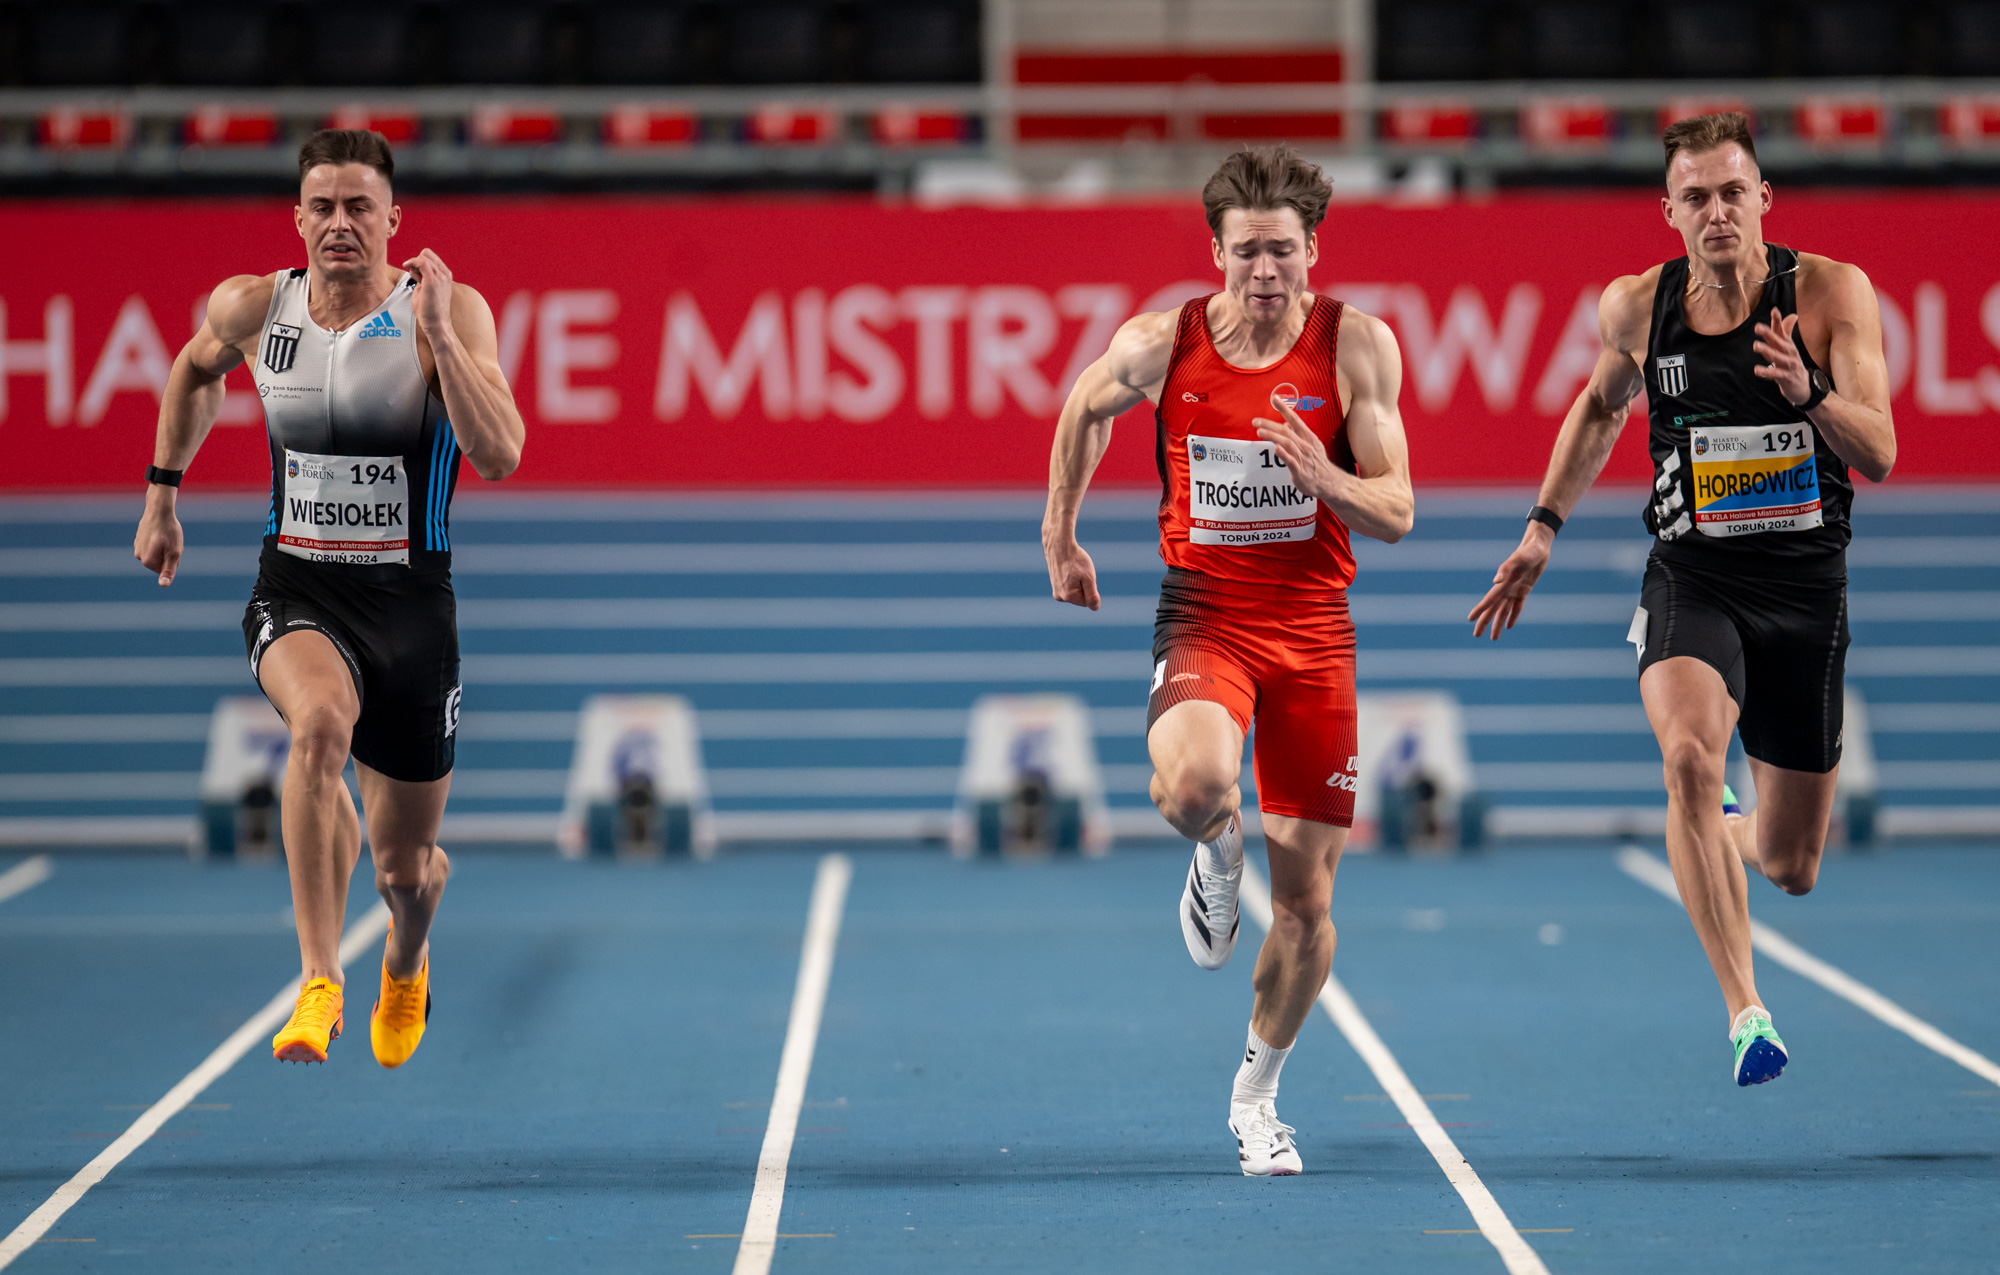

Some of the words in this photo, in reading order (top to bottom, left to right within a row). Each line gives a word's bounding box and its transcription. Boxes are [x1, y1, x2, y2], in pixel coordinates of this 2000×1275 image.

[280, 327, 290, 335] W
[359, 327, 402, 339] adidas
[1711, 440, 1747, 452] TORUŃ
[1762, 429, 1807, 452] 191
[1209, 453, 1244, 464] TORUŃ
[301, 469, 335, 480] TORUŃ
[350, 464, 397, 485] 194
[1698, 465, 1816, 498] HORBOWICZ
[289, 497, 403, 527] WIESIOŁEK
[1712, 512, 1729, 521] PZLA
[1729, 511, 1756, 519] Halowe
[1757, 508, 1799, 518] Mistrzostwa
[1800, 503, 1818, 513] Polski
[1194, 519, 1206, 527] 68.
[1206, 521, 1222, 529] PZLA
[1251, 520, 1295, 529] Mistrzostwa
[1726, 520, 1765, 533] TORUŃ
[1768, 519, 1796, 529] 2024
[1220, 531, 1260, 542] TORUŃ
[1262, 531, 1291, 540] 2024
[285, 537, 296, 545] 68.
[297, 539, 314, 547] PZLA
[314, 541, 339, 549] Halowe
[340, 542, 383, 550] Mistrzostwa
[384, 541, 405, 549] Polski
[309, 552, 347, 563] TORUŃ
[350, 554, 378, 563] 2024
